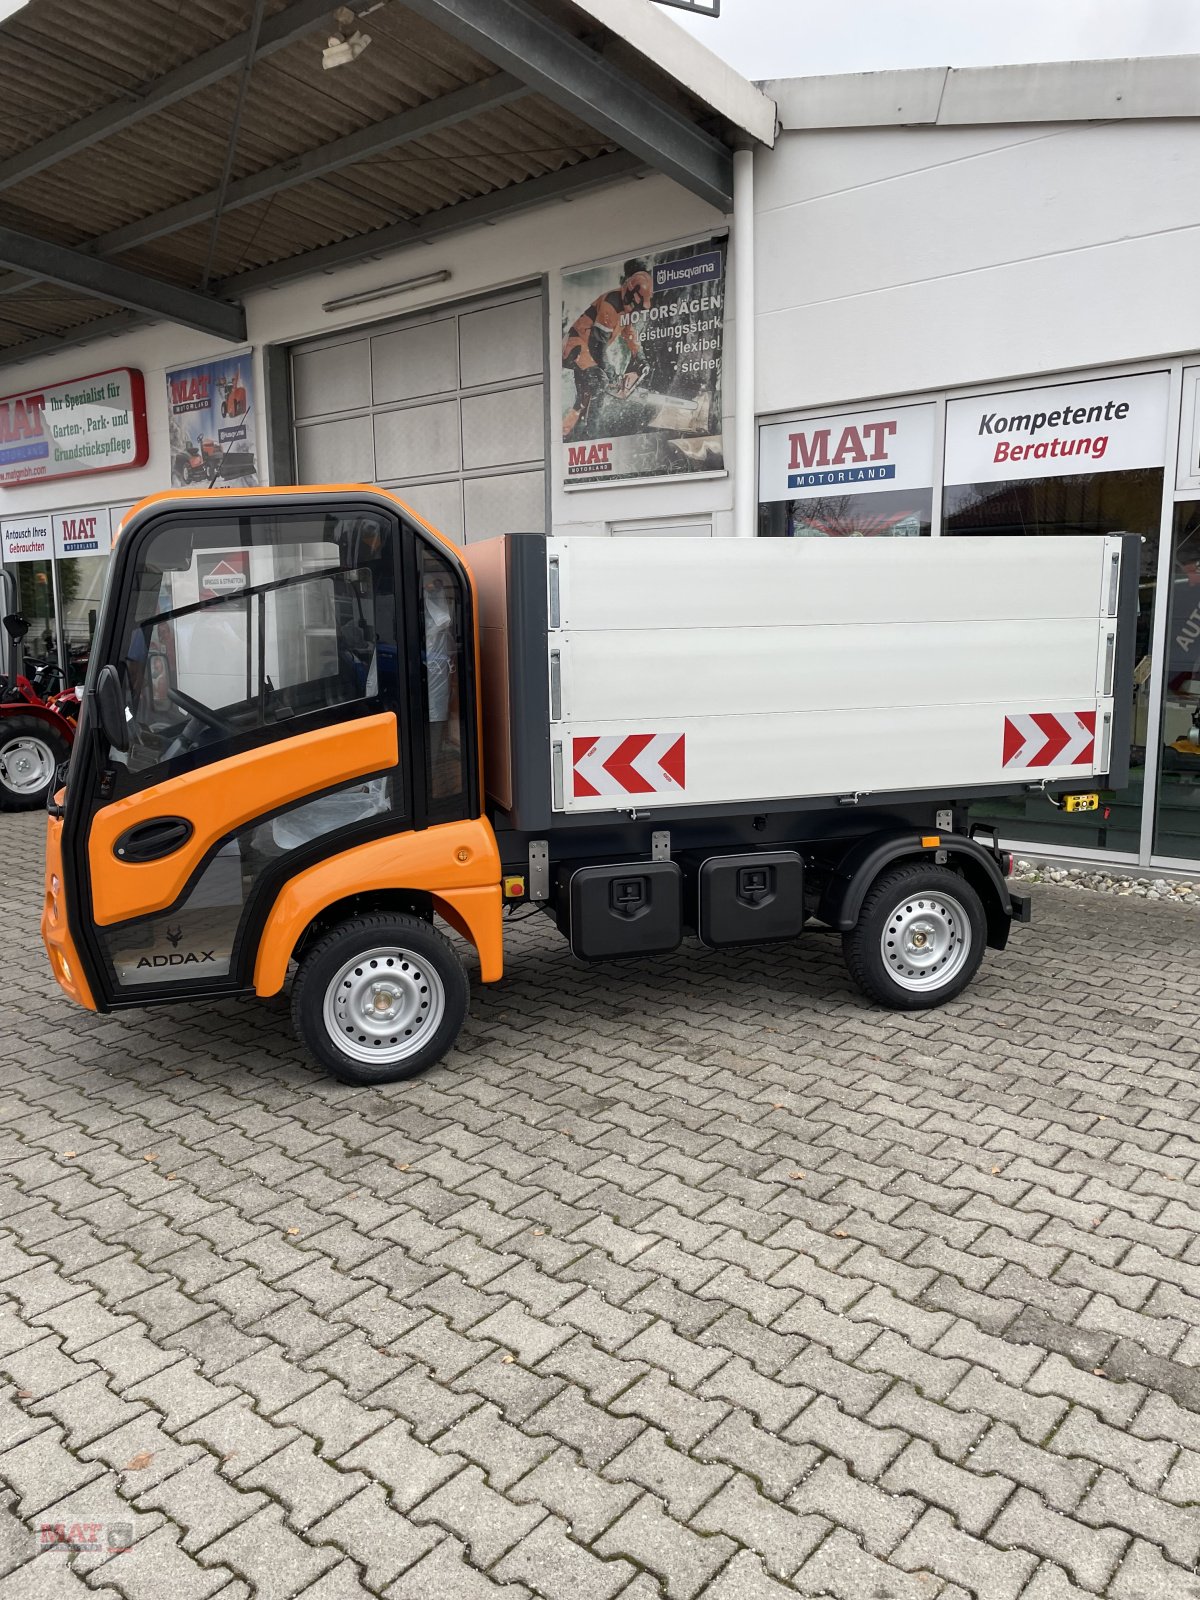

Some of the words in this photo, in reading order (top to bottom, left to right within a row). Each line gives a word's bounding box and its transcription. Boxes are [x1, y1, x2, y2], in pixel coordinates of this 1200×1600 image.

[667, 261, 715, 282] Husqvarna
[619, 295, 722, 328] MOTORSÄGEN
[636, 316, 721, 342] leistungsstark
[675, 336, 721, 355] flexibel
[681, 358, 721, 373] sicher
[50, 397, 63, 411] Ihr
[65, 384, 105, 410] Spezialist
[107, 383, 121, 398] für
[170, 374, 211, 404] MAT
[175, 400, 209, 413] MOTORLAND
[53, 424, 85, 439] Garten-,
[87, 414, 110, 432] Park-
[112, 410, 129, 426] und
[978, 399, 1130, 439] Kompetente
[54, 438, 131, 462] Grundstückspflege
[568, 443, 613, 466] MAT
[787, 420, 898, 470] MAT
[993, 433, 1109, 463] Beratung
[571, 464, 609, 474] MOTORLAND
[796, 467, 887, 486] MOTORLAND
[32, 526, 47, 538] Ihres
[62, 518, 97, 541] MAT
[9, 541, 45, 554] Gebrauchten
[66, 542, 97, 551] MOTORLAND
[1175, 601, 1200, 653] AUT
[136, 950, 217, 969] ADDAX
